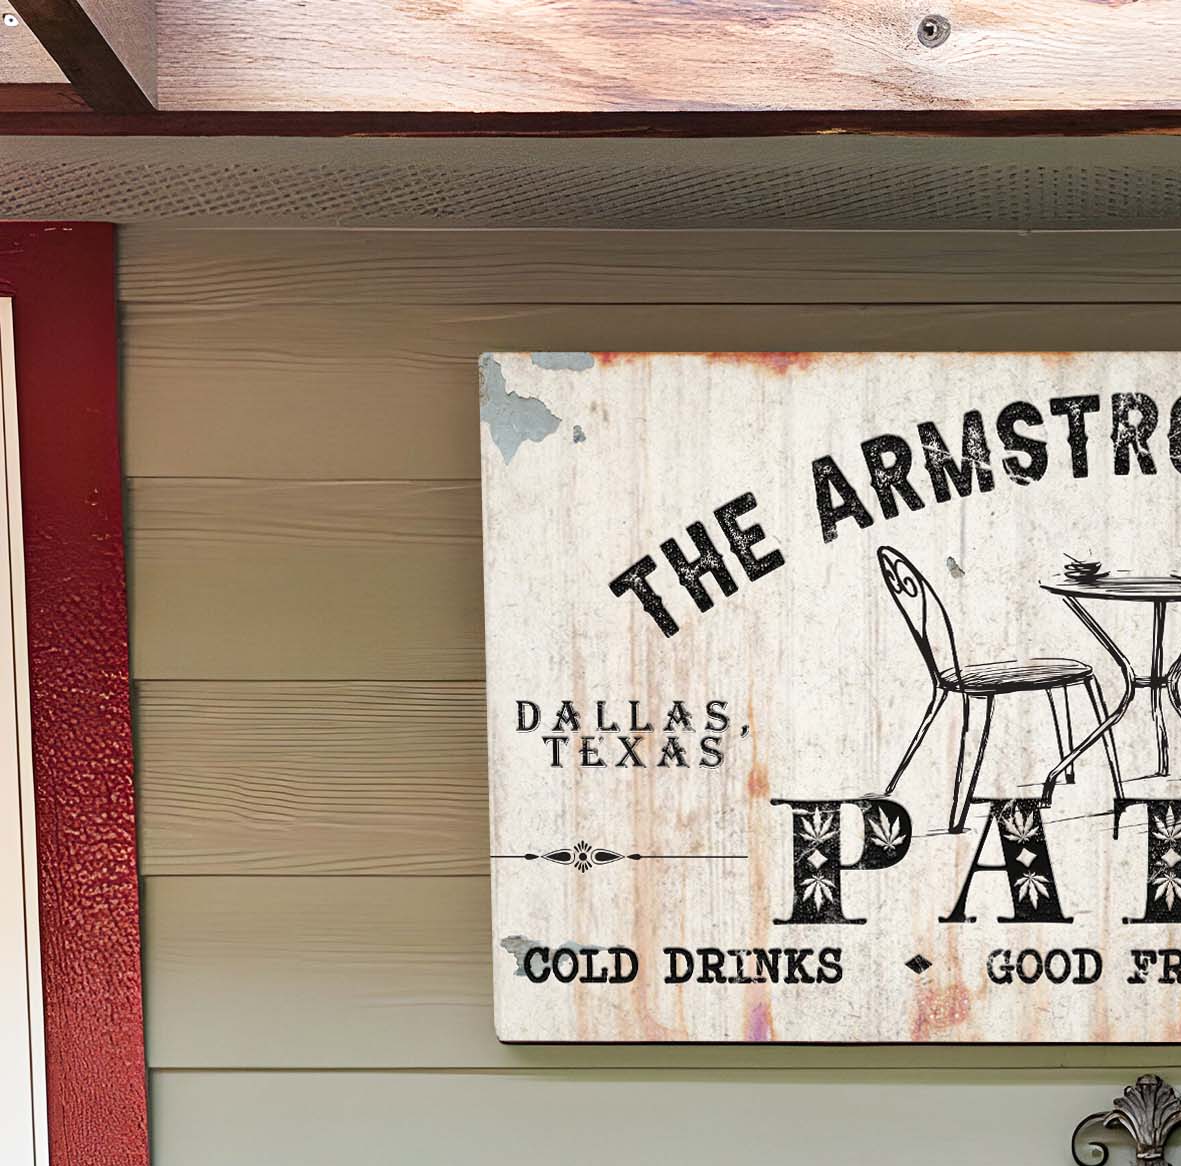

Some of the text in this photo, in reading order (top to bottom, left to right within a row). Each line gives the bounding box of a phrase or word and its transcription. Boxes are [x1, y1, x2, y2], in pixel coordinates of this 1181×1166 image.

[609, 492, 785, 638] THE
[515, 700, 750, 739] DALLAS,
[541, 736, 724, 769] TEXAS
[523, 947, 638, 983] COLD
[664, 947, 842, 984] DRINKS
[987, 948, 1102, 984] GOOD
